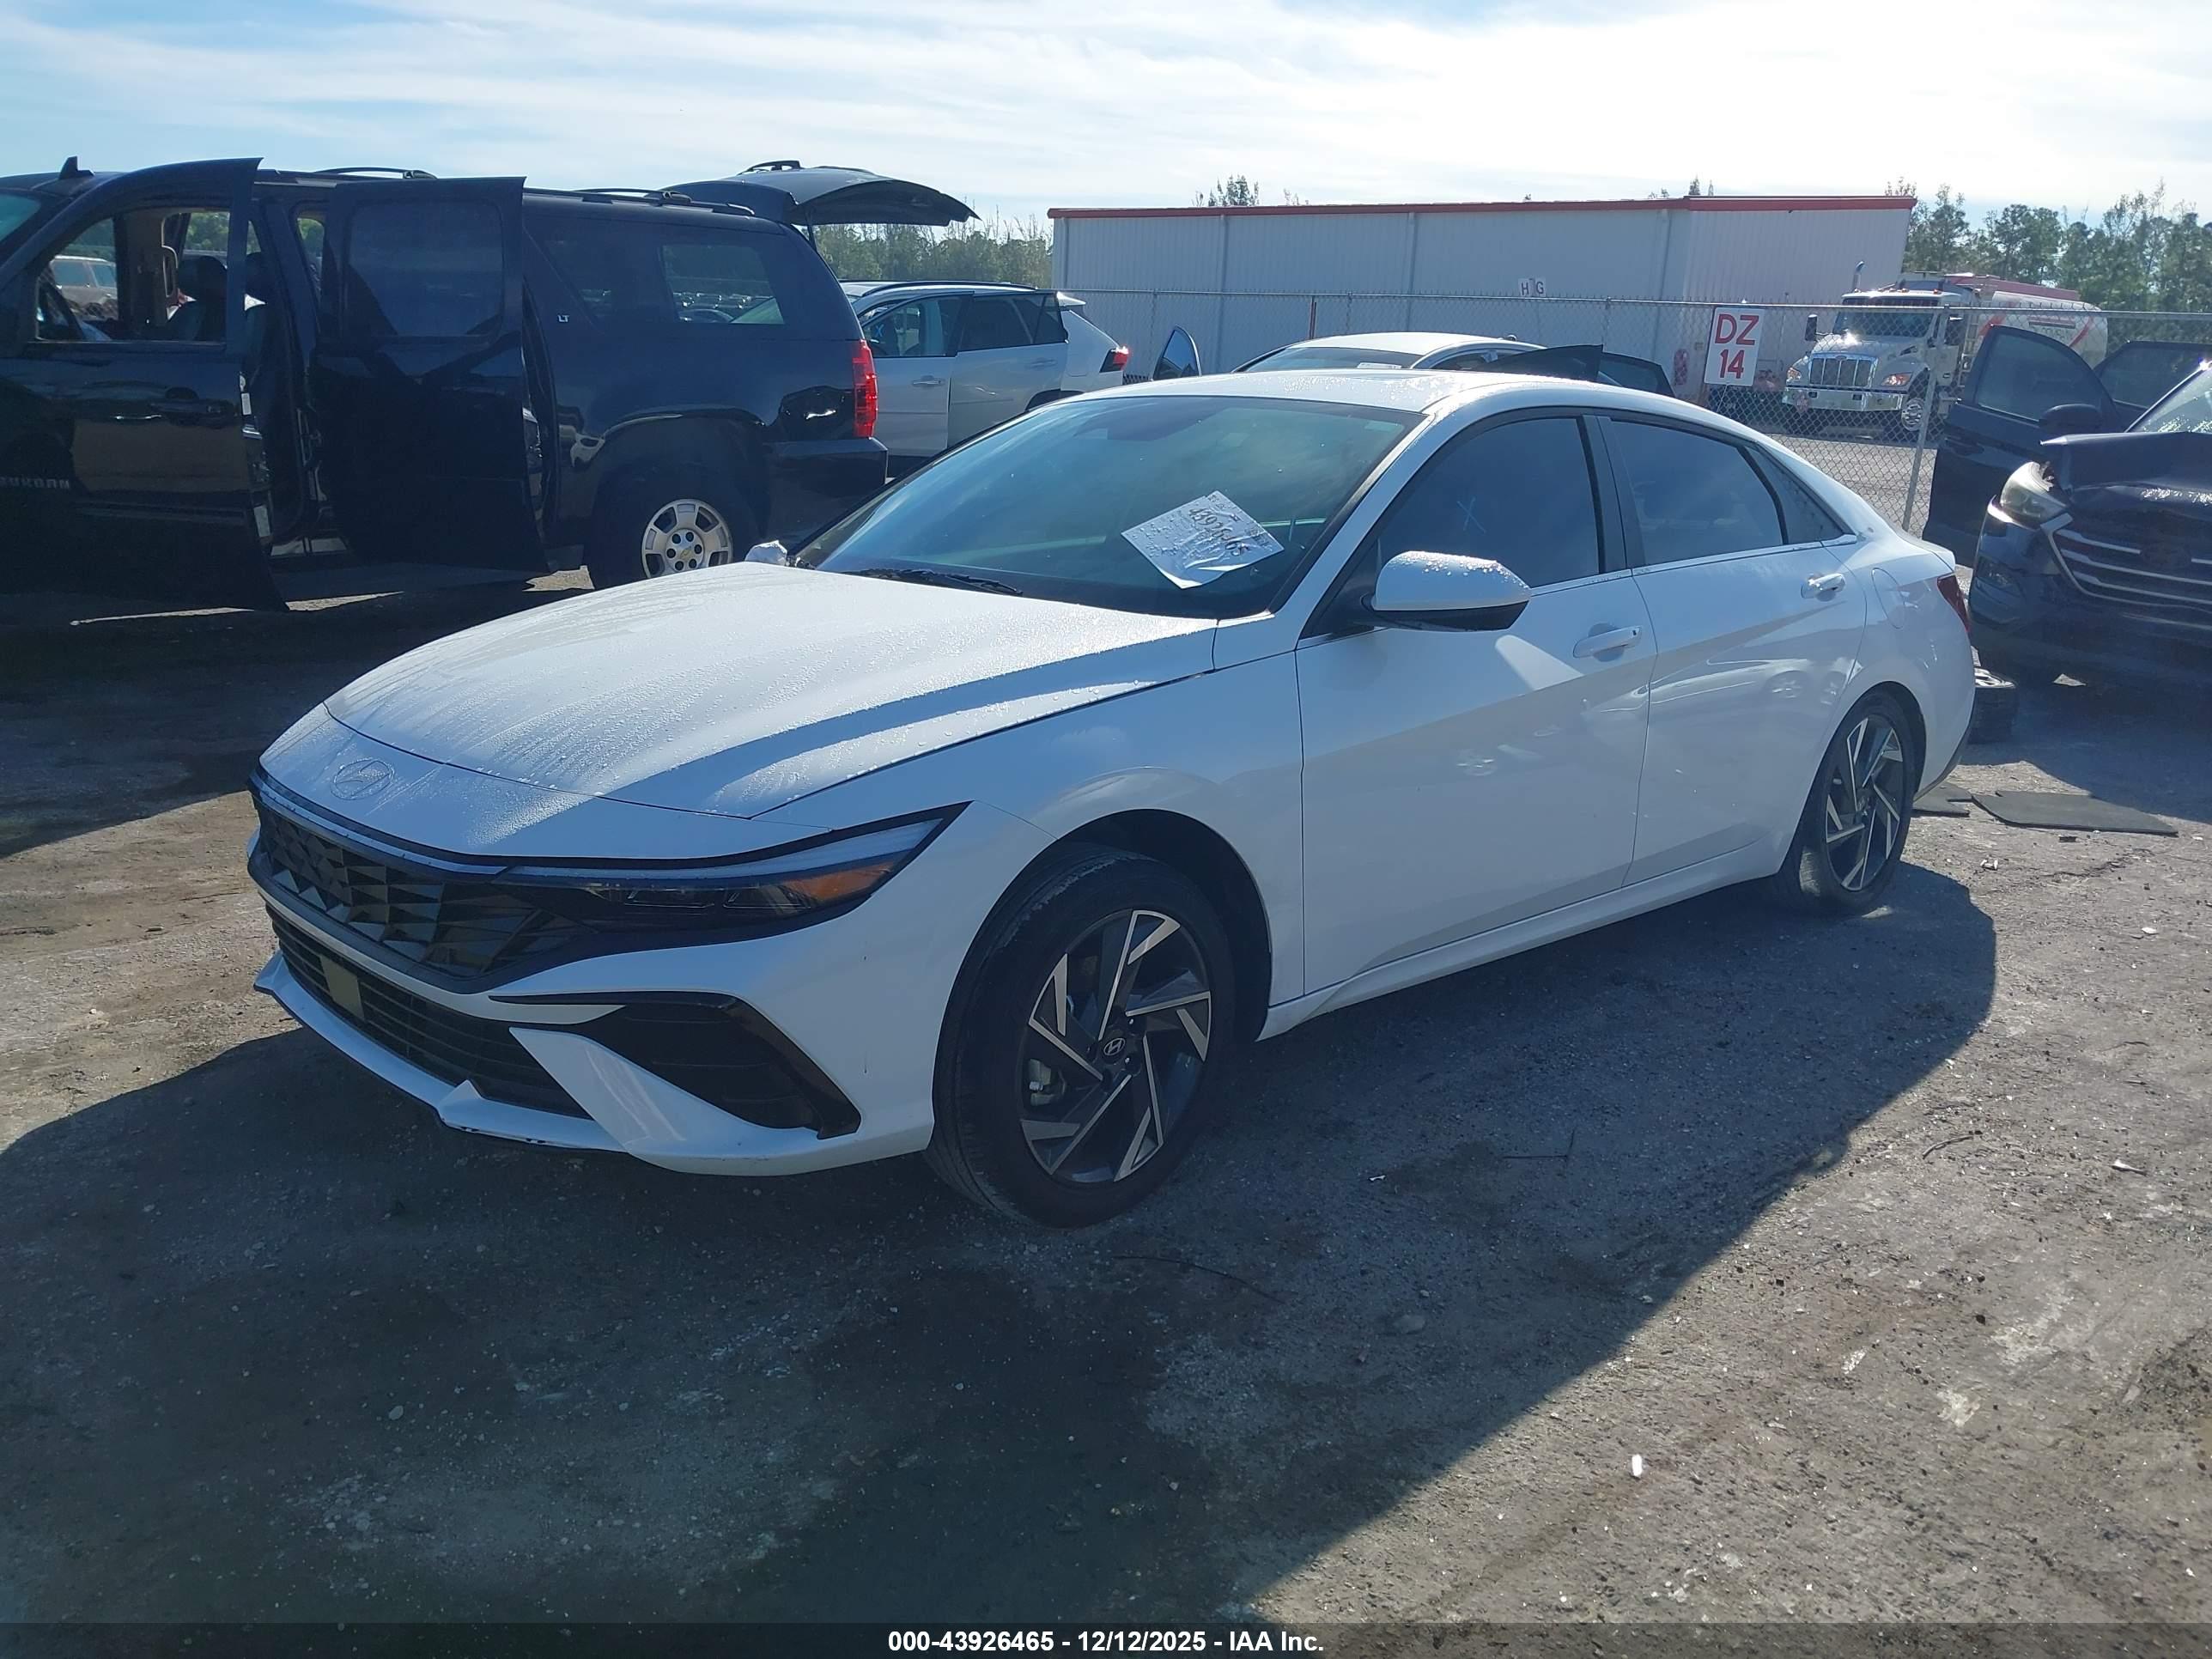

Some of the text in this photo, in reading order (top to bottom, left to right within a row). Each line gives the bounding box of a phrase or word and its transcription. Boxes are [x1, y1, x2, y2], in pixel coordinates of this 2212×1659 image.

[1521, 281, 1544, 296] H G
[557, 314, 570, 323] LT
[1715, 313, 1759, 346] DZ
[1720, 349, 1745, 379] 14
